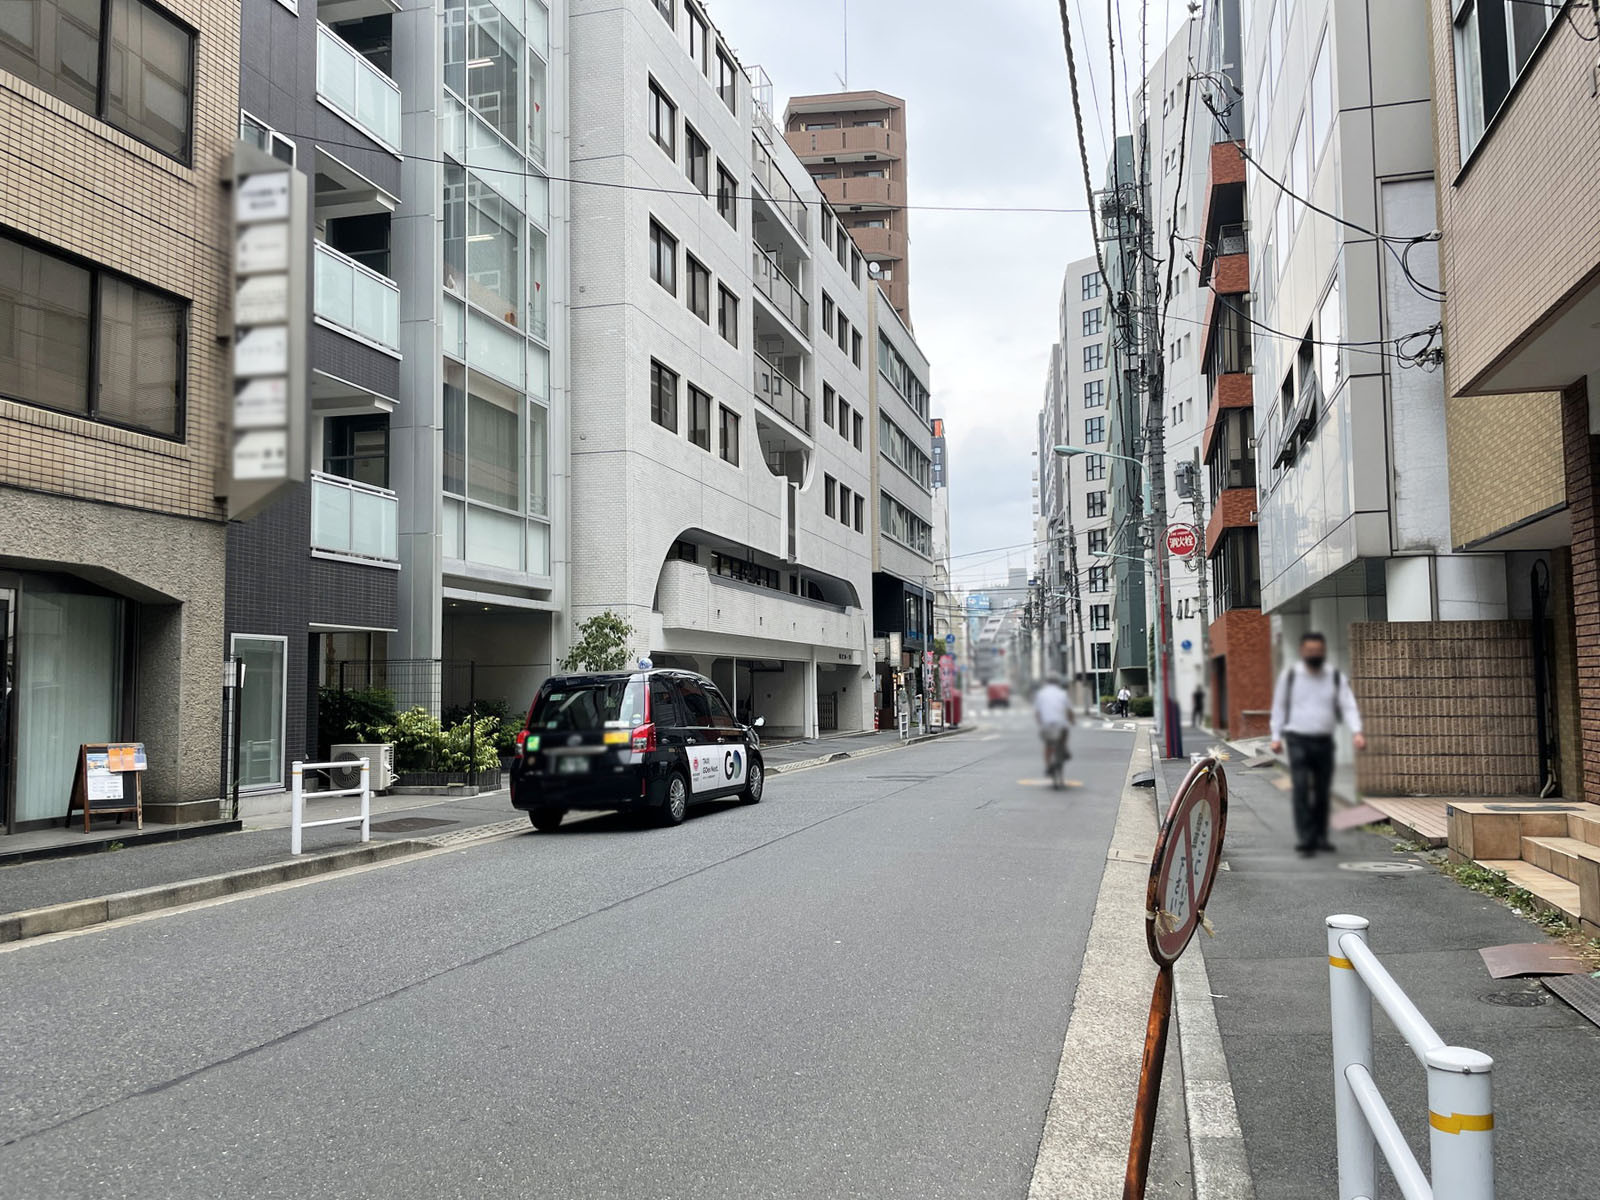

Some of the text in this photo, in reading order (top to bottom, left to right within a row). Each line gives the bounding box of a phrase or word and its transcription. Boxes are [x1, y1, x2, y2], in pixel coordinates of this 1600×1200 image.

[1169, 535, 1194, 549] 消火栓
[725, 750, 742, 780] GO
